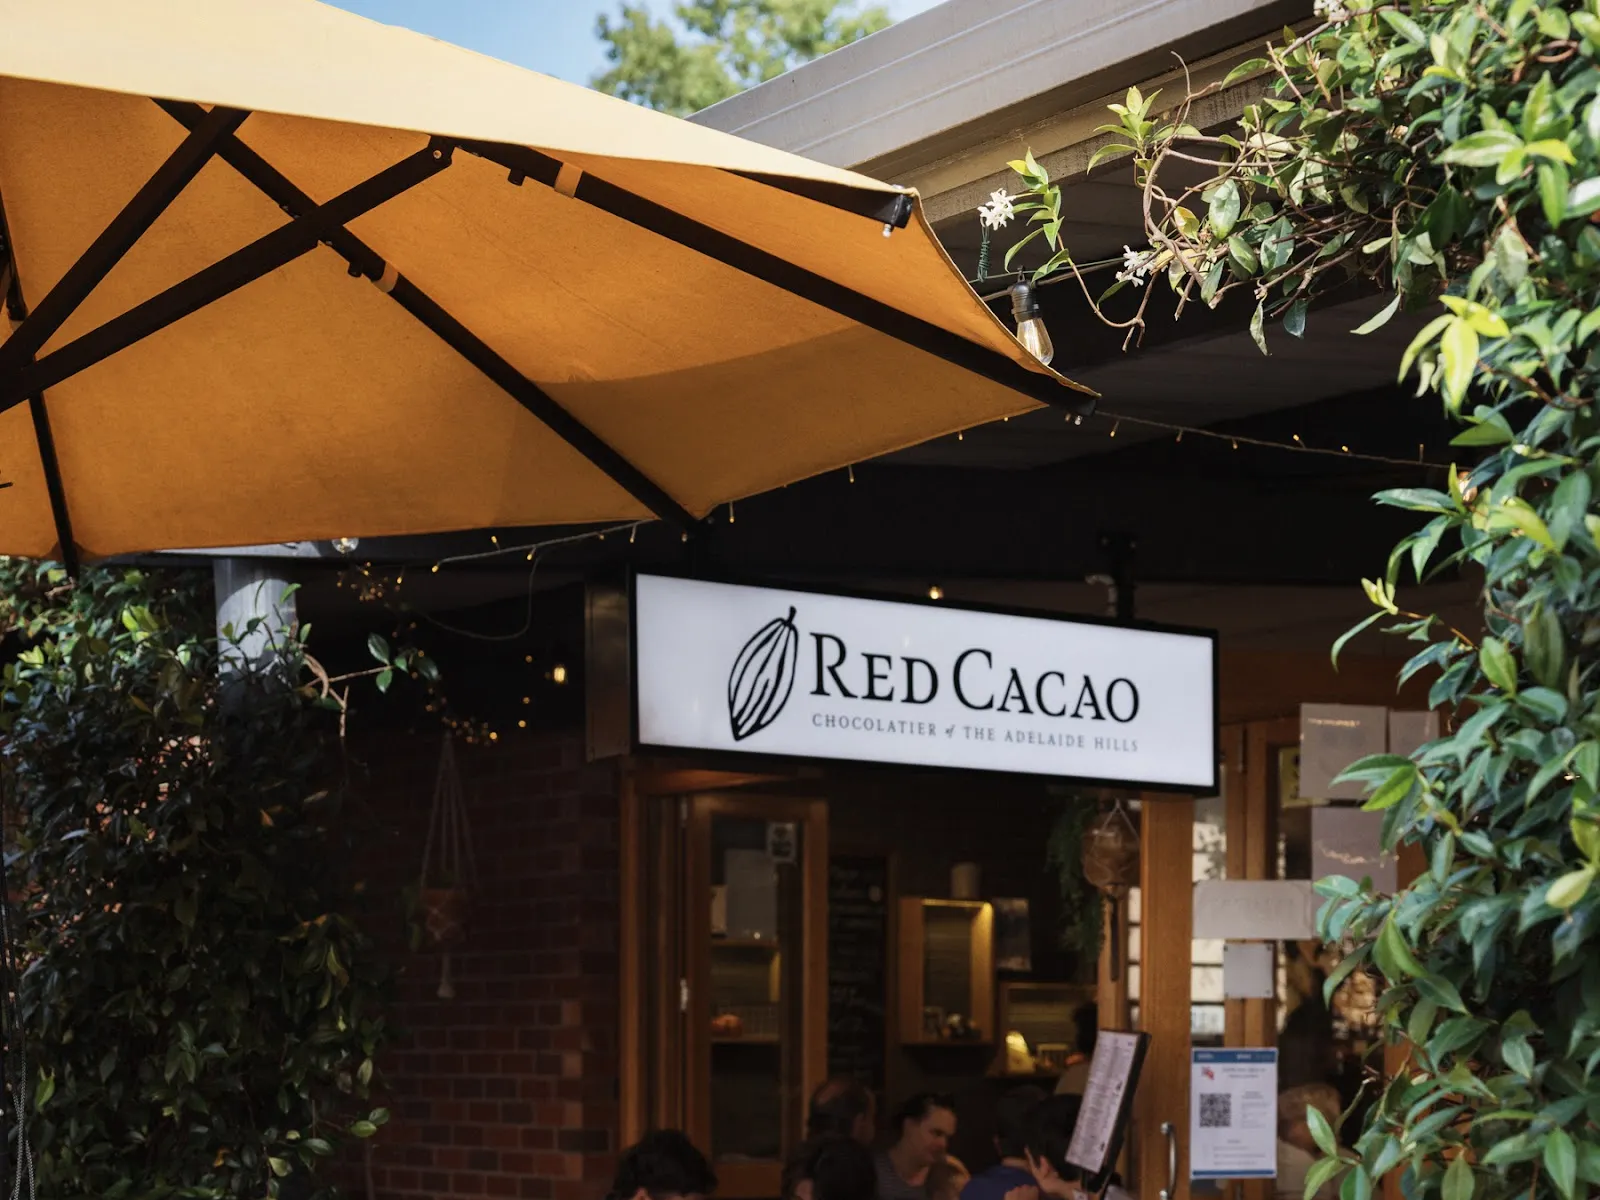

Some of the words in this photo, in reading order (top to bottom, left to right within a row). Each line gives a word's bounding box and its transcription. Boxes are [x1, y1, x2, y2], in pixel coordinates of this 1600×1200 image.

[809, 632, 939, 704] RED
[953, 648, 1140, 723] CACAO
[812, 713, 937, 737] CHOCOLATIER
[944, 724, 956, 739] of
[964, 726, 995, 741] THE
[1004, 729, 1085, 749] ADELAIDE
[1095, 736, 1139, 752] HILLS
